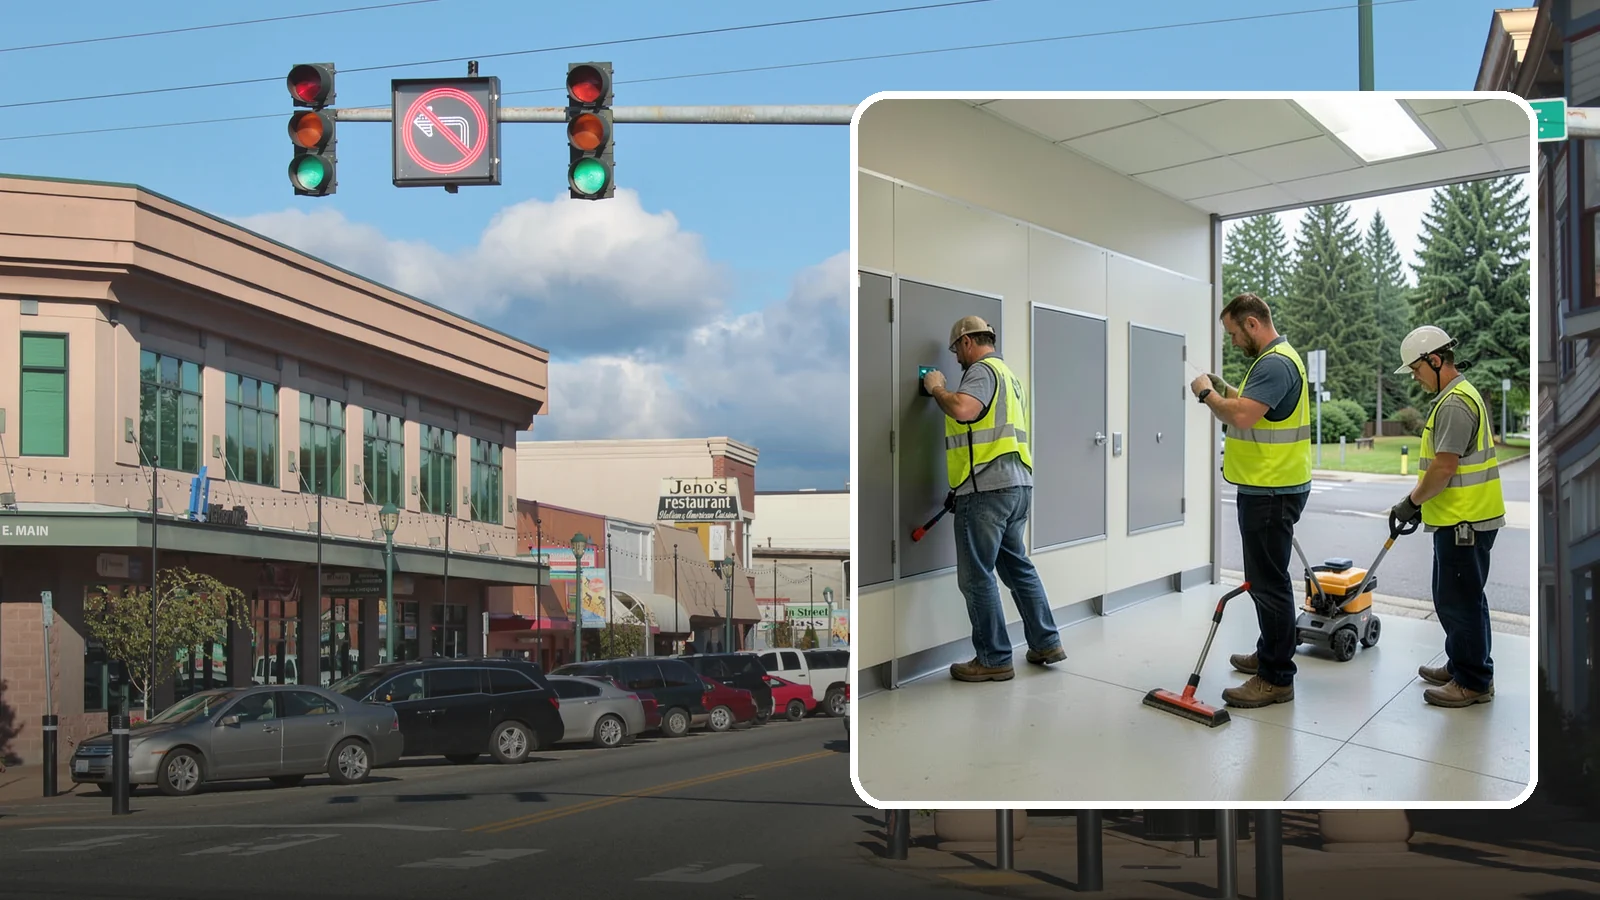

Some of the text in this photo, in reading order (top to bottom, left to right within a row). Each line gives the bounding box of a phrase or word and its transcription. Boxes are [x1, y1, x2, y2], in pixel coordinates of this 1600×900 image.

[669, 480, 727, 494] Jeno's
[665, 496, 731, 509] restaurant
[658, 510, 681, 519] Italian
[686, 509, 714, 519] American
[715, 509, 738, 519] Cuisine
[2, 525, 49, 536] E. MAIN
[797, 608, 828, 616] Street
